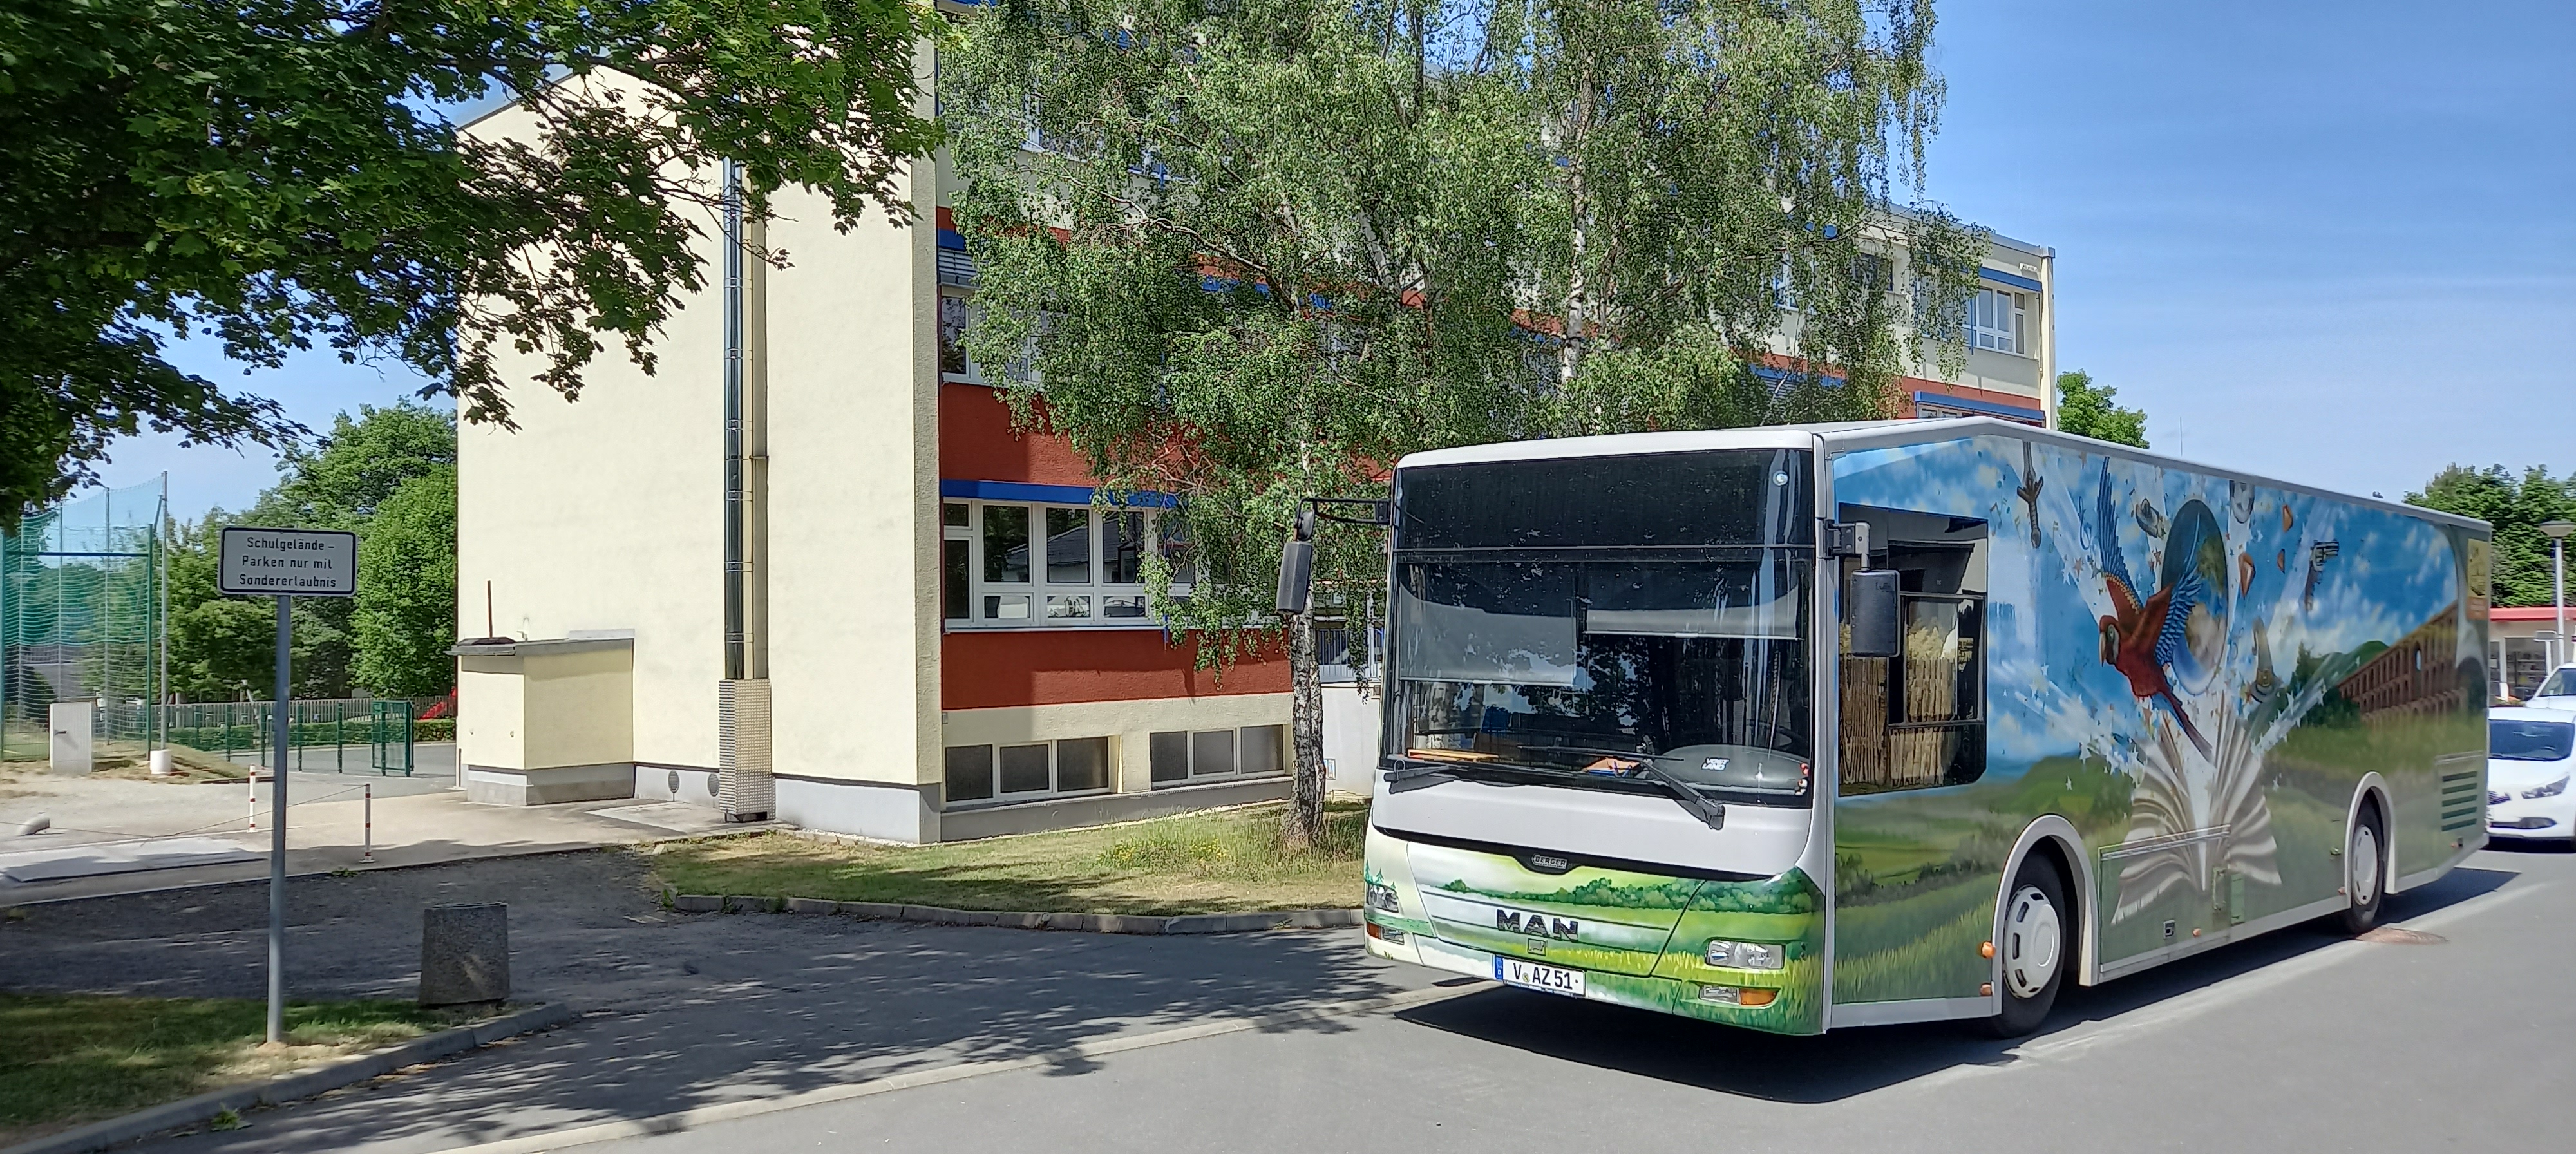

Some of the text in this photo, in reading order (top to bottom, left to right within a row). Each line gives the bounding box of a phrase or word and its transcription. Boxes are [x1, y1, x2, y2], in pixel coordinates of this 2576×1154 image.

[247, 536, 325, 552] Schulgelände
[242, 555, 332, 569] Parken nur mit
[239, 574, 336, 588] Sondererlaubnis
[1535, 856, 1566, 866] BERGER
[1497, 909, 1579, 943] MAN
[1513, 962, 1522, 980] V
[1532, 967, 1551, 986] AZ
[1554, 970, 1573, 990] 51
